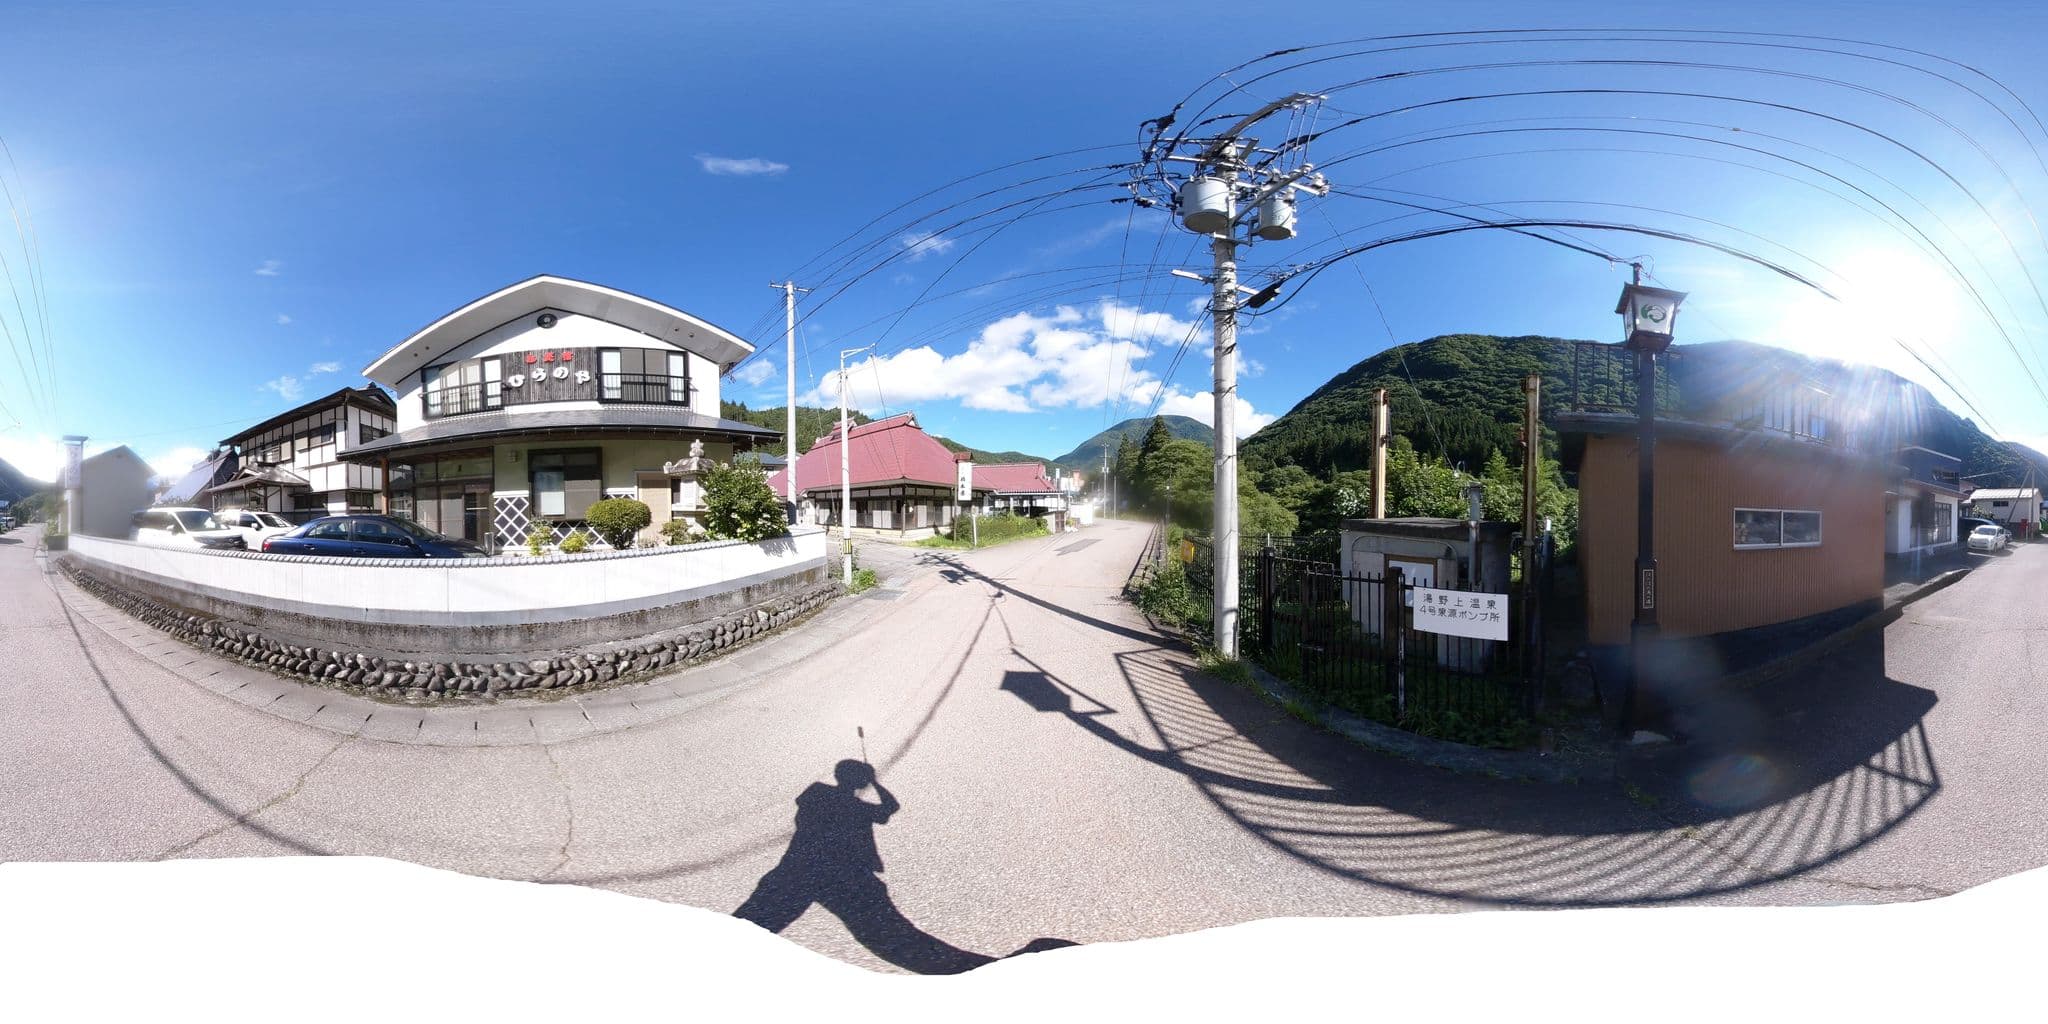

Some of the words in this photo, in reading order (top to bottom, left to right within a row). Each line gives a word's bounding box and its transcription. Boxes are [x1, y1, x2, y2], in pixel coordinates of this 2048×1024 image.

[1423, 593, 1497, 610] 湯野上温泉
[1419, 605, 1500, 622] 4号泉源ポンプ所
